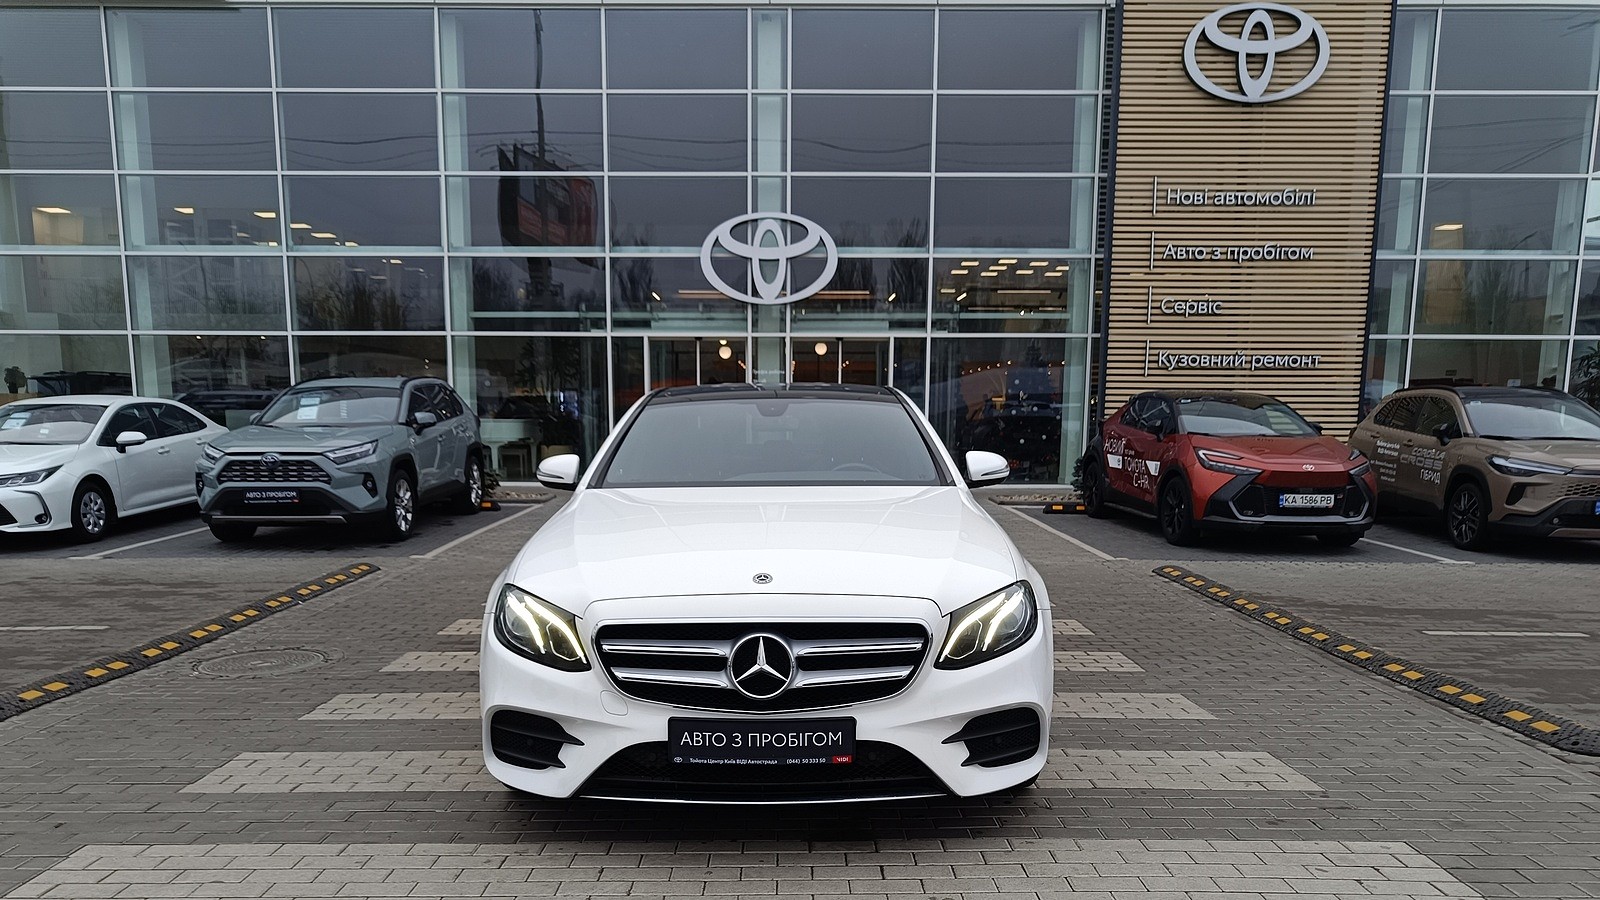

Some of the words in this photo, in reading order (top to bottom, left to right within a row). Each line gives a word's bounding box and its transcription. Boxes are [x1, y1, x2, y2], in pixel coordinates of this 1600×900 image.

[1167, 188, 1209, 205] Нові
[1214, 188, 1317, 205] автомобілі
[1162, 243, 1206, 259] Авто
[1211, 246, 1221, 260] з
[1227, 243, 1314, 264] пробігом
[1161, 297, 1223, 318] Сервіс
[1158, 349, 1245, 370] Кузовний
[1251, 354, 1321, 371] ремонт
[1124, 456, 1147, 474] TOYOTA
[1400, 453, 1443, 470] CROSS
[1300, 495, 1318, 504] 1586
[680, 731, 727, 747] АВТО
[748, 731, 842, 748] ПРОБІГОМ
